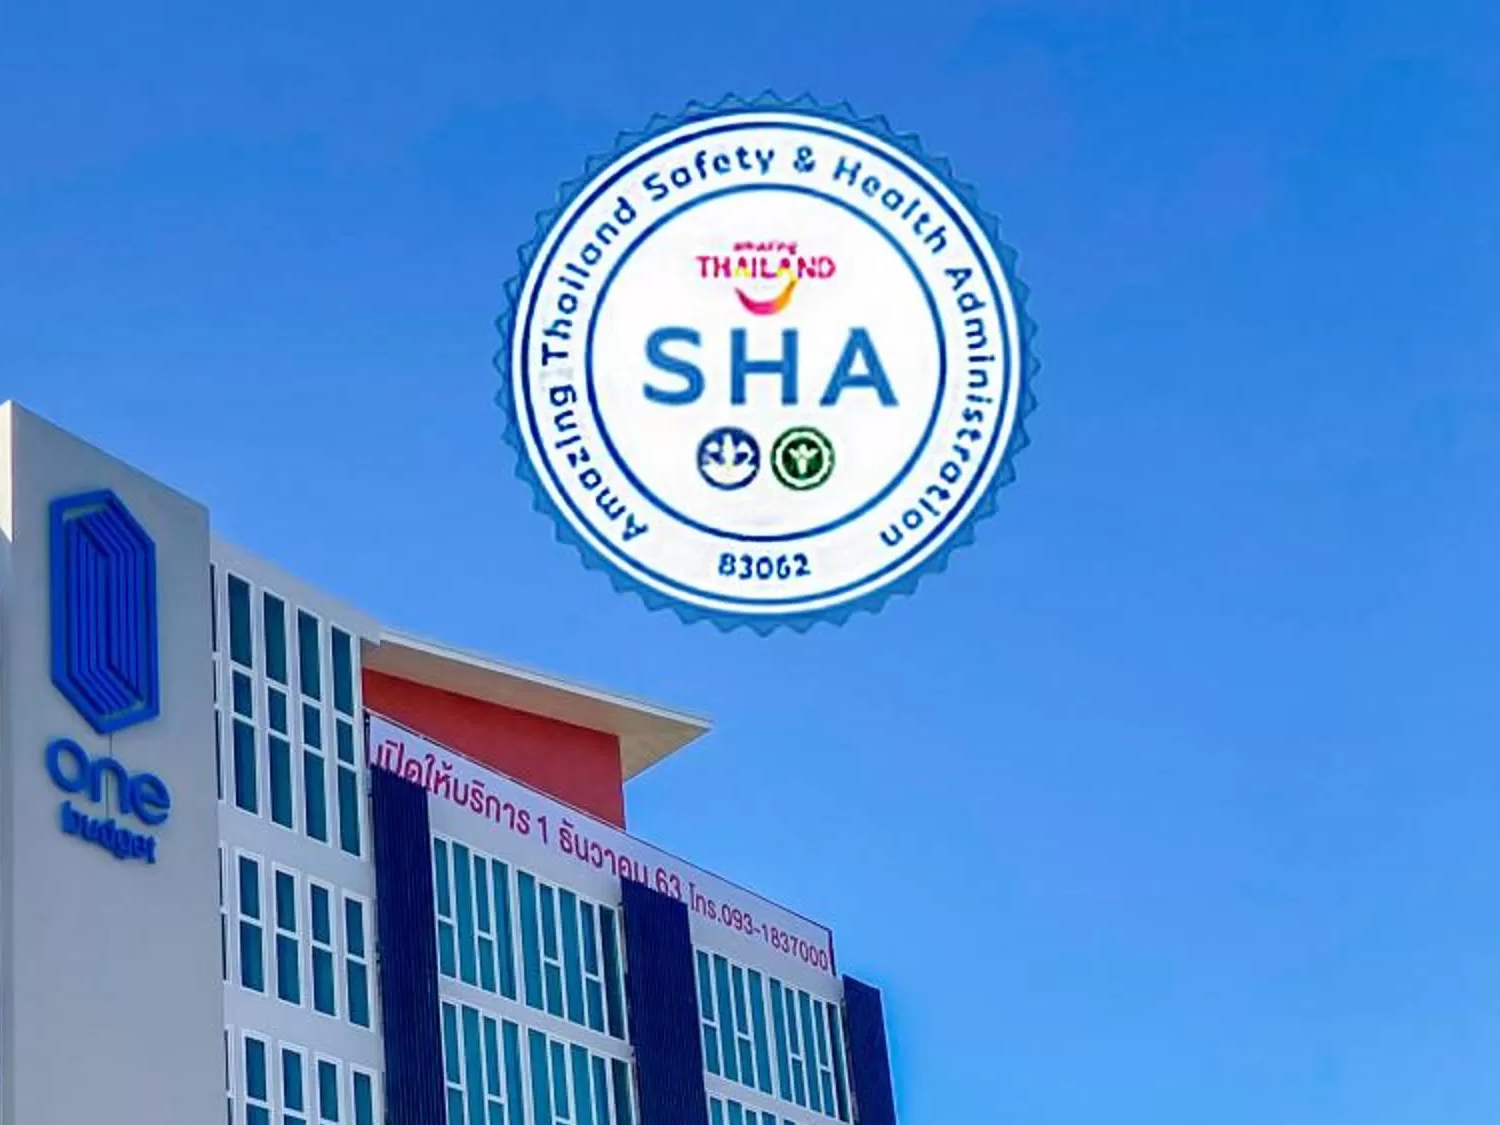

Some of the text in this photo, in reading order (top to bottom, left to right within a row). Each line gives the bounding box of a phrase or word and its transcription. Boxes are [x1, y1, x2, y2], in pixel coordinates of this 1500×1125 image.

[46, 738, 171, 826] one
[60, 801, 156, 864] budget
[537, 815, 548, 845] 1
[655, 866, 682, 901] 63
